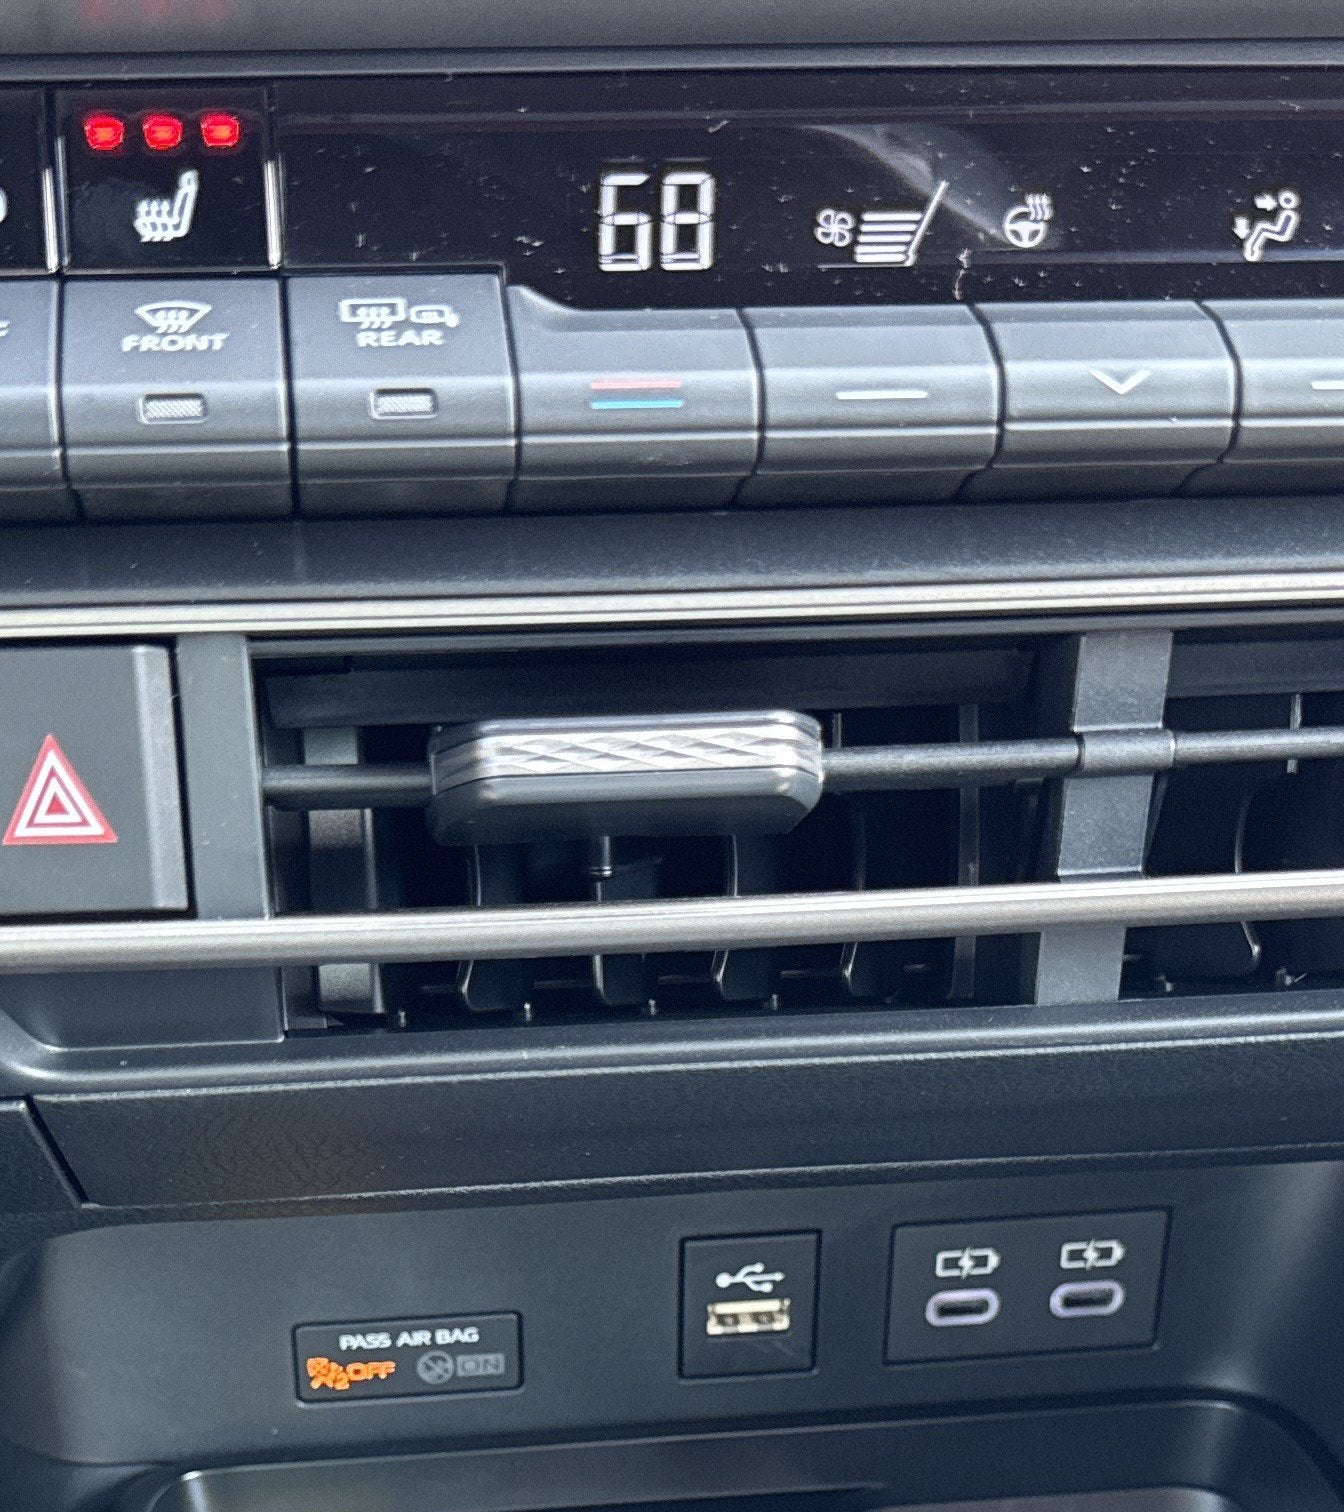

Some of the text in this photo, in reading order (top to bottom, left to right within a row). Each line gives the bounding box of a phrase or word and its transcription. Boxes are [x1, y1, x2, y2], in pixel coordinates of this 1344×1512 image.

[598, 171, 715, 272] 68
[121, 332, 231, 352] FRONT
[356, 329, 447, 348] REAR
[339, 1326, 480, 1351] PASS AIR BAG
[346, 1359, 397, 1382] OFF
[458, 1353, 505, 1377] ON
